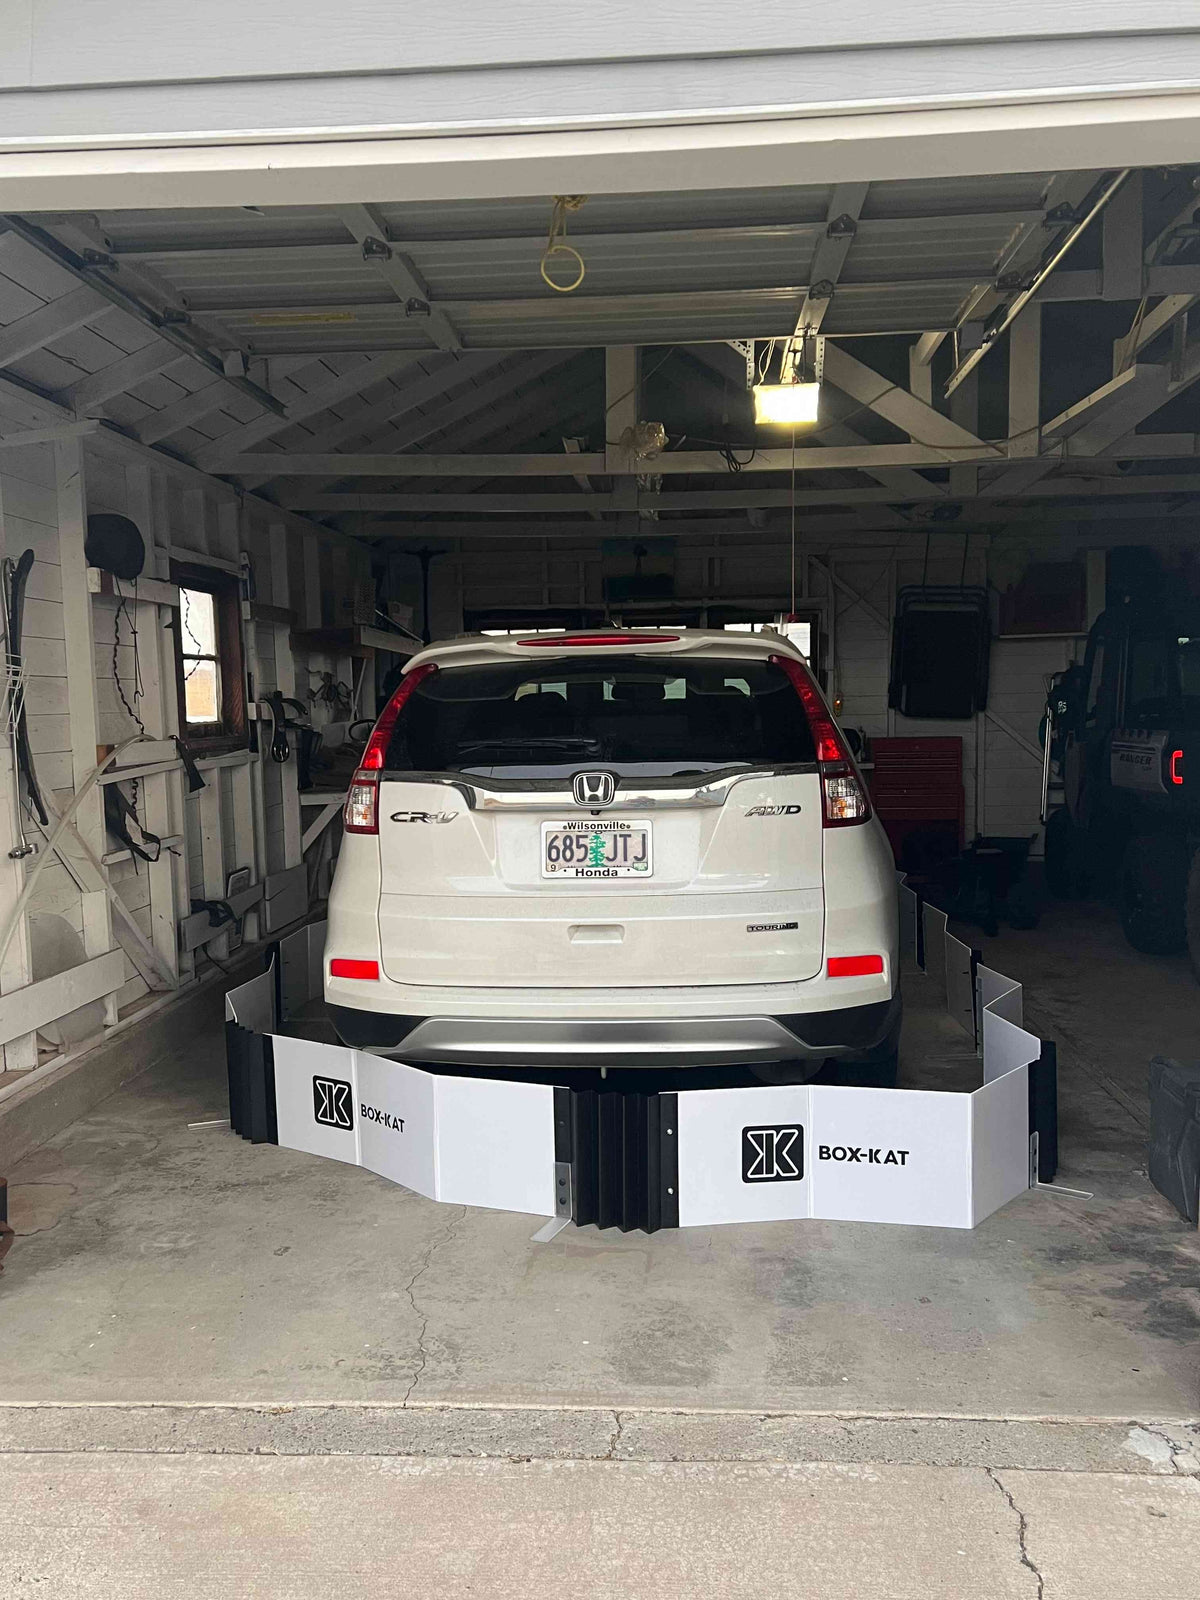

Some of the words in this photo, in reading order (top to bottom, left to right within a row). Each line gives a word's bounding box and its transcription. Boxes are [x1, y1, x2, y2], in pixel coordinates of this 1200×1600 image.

[390, 811, 459, 824] CR-V
[744, 805, 802, 817] AWD
[567, 822, 626, 830] Wilsonville
[547, 834, 589, 863] 685
[605, 833, 647, 862] JTJ
[575, 868, 618, 877] Honda
[360, 1103, 405, 1133] BOX-KAT
[818, 1145, 910, 1166] BOX-KAT
